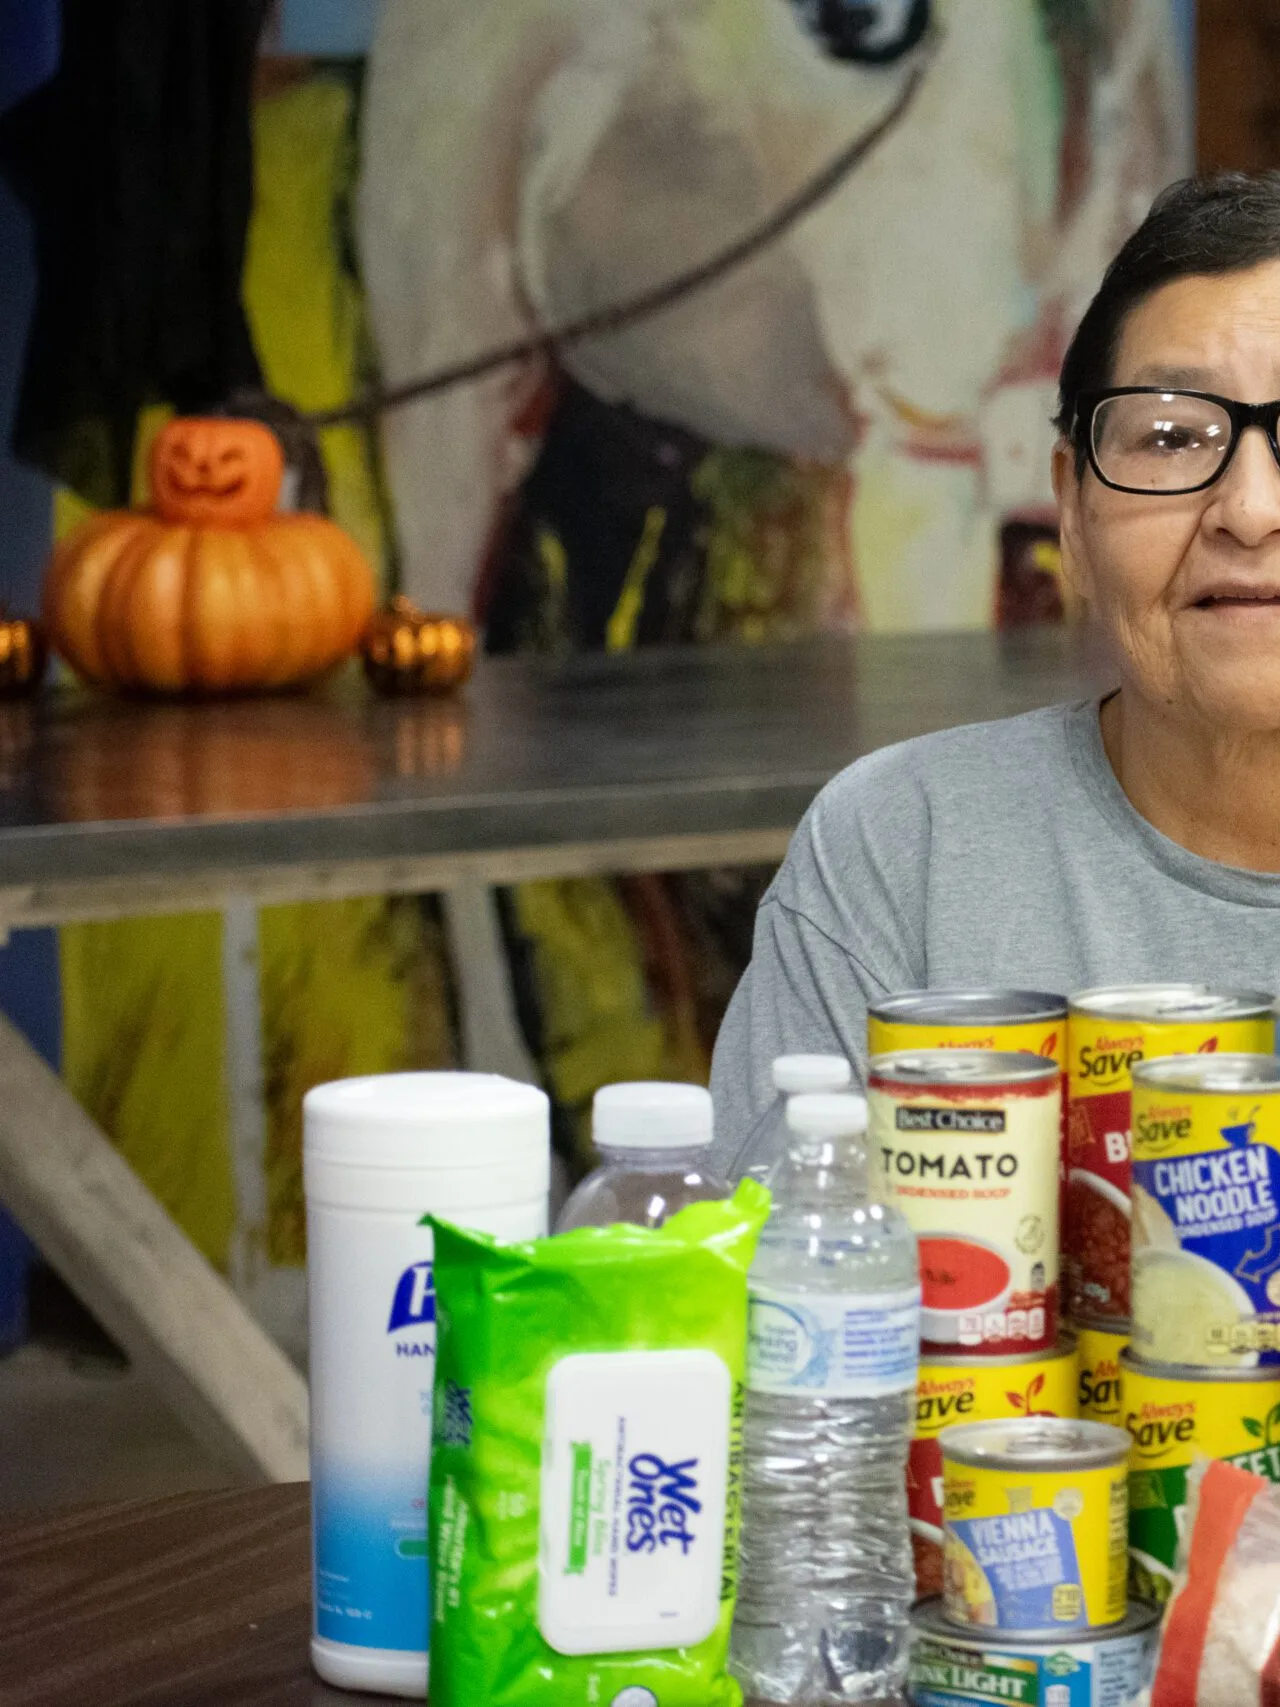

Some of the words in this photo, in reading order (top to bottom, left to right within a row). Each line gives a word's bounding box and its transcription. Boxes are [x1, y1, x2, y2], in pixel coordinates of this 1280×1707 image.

[1097, 1036, 1145, 1050] Always
[1079, 1046, 1144, 1079] Save
[900, 1109, 932, 1129] Best
[935, 1110, 1004, 1132] Choice
[1136, 1114, 1192, 1144] Save
[1148, 1105, 1192, 1120] Always
[881, 1146, 1018, 1179] TOMATO
[1153, 1146, 1269, 1196] CHICKEN
[1175, 1181, 1276, 1225] NOODLE
[916, 1391, 974, 1420] ave
[1140, 1401, 1196, 1418] Always
[1126, 1412, 1195, 1447] Save
[658, 1457, 702, 1556] Wet
[967, 1509, 1056, 1546] VIENNA
[977, 1537, 1060, 1567] SAUSAGE
[950, 1665, 1028, 1700] LIGHT
